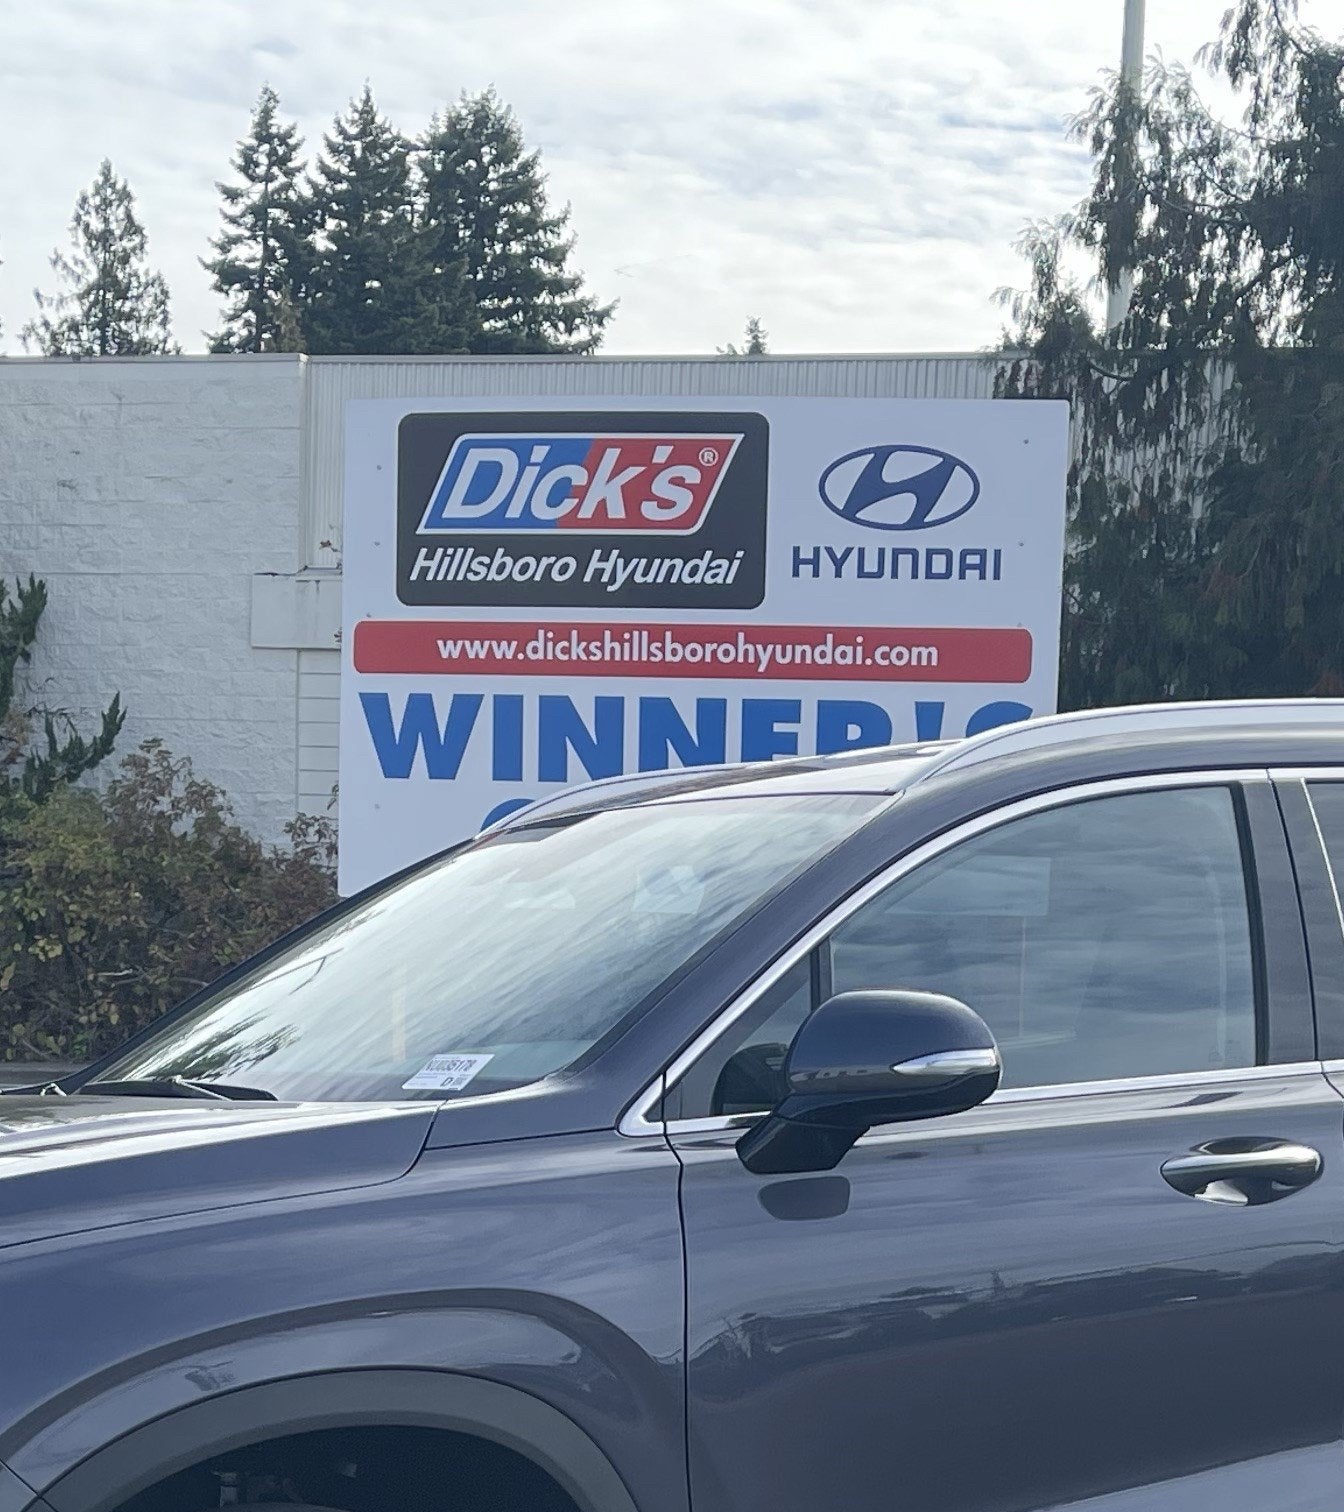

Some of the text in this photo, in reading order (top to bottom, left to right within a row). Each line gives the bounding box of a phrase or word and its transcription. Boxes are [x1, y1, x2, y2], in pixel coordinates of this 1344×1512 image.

[409, 547, 746, 593] Hillsboro Hyundai
[791, 545, 1003, 582] HYUNDAI
[437, 630, 939, 675] www.dickshillsborohyundai.com
